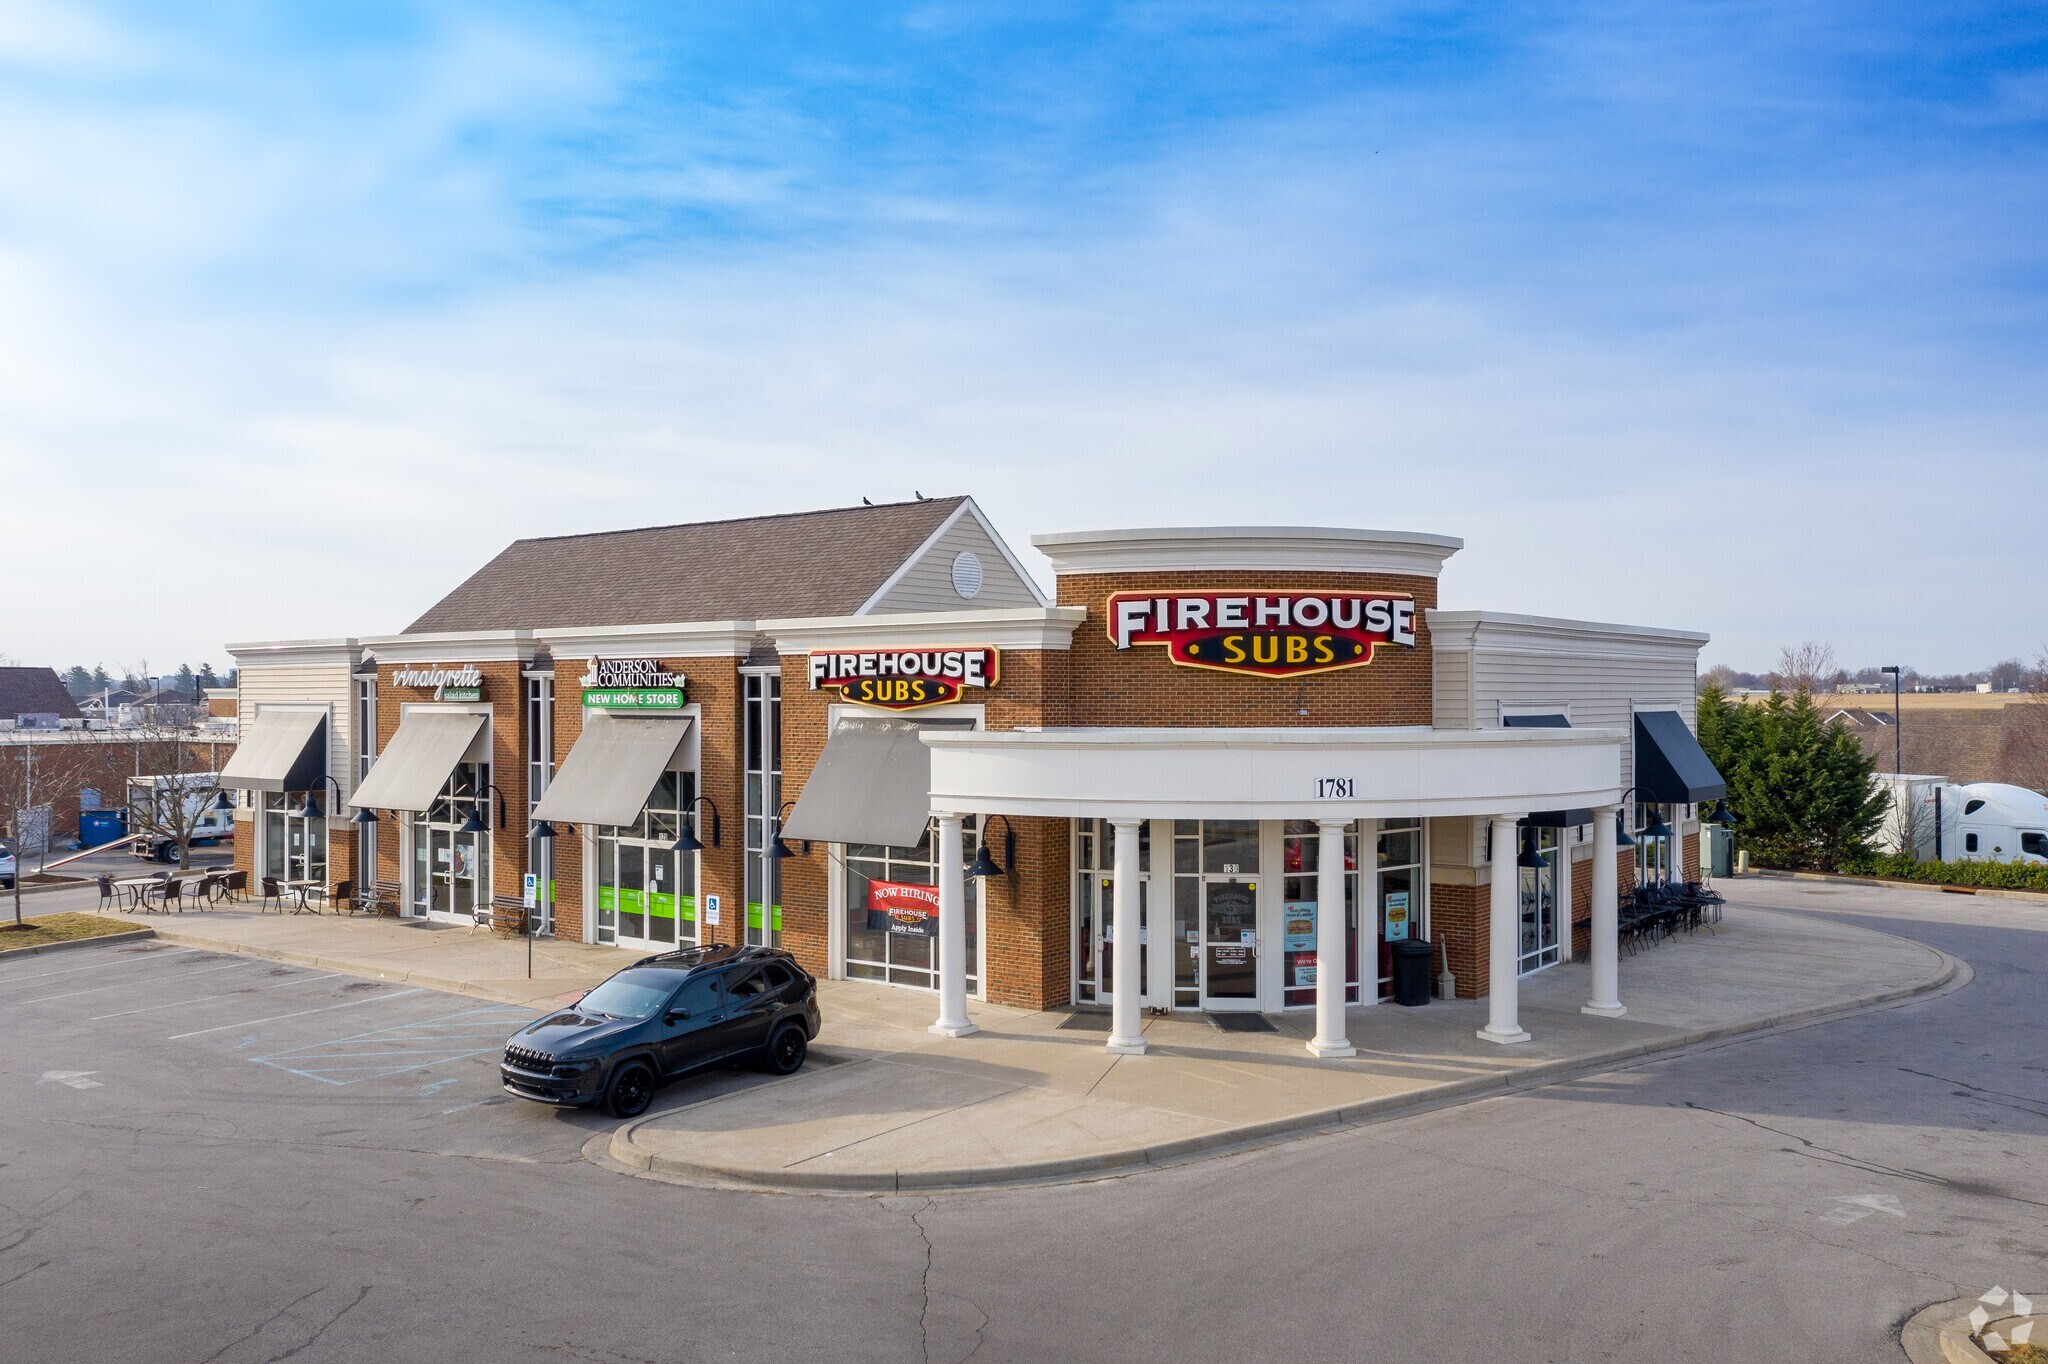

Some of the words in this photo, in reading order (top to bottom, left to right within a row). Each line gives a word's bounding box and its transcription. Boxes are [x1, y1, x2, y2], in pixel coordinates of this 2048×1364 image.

[1115, 597, 1416, 650] FIREHOUSE
[1223, 635, 1335, 663] SUBS
[599, 660, 657, 673] ANDERSON
[809, 648, 986, 691] FIREHOUSE
[392, 664, 483, 701] vinaigrette
[598, 673, 674, 687] COMMUNITIES
[444, 691, 458, 700] salad
[459, 691, 479, 700] kitchen
[861, 679, 926, 702] SUBS
[588, 694, 611, 704] NEW
[613, 694, 644, 704] HOME
[646, 694, 679, 704] STORE
[1317, 777, 1356, 798] 1781
[874, 887, 898, 900] NOW
[888, 908, 928, 920] FIREHOUSE
[891, 924, 907, 932] Apply
[908, 925, 925, 934] Inside
